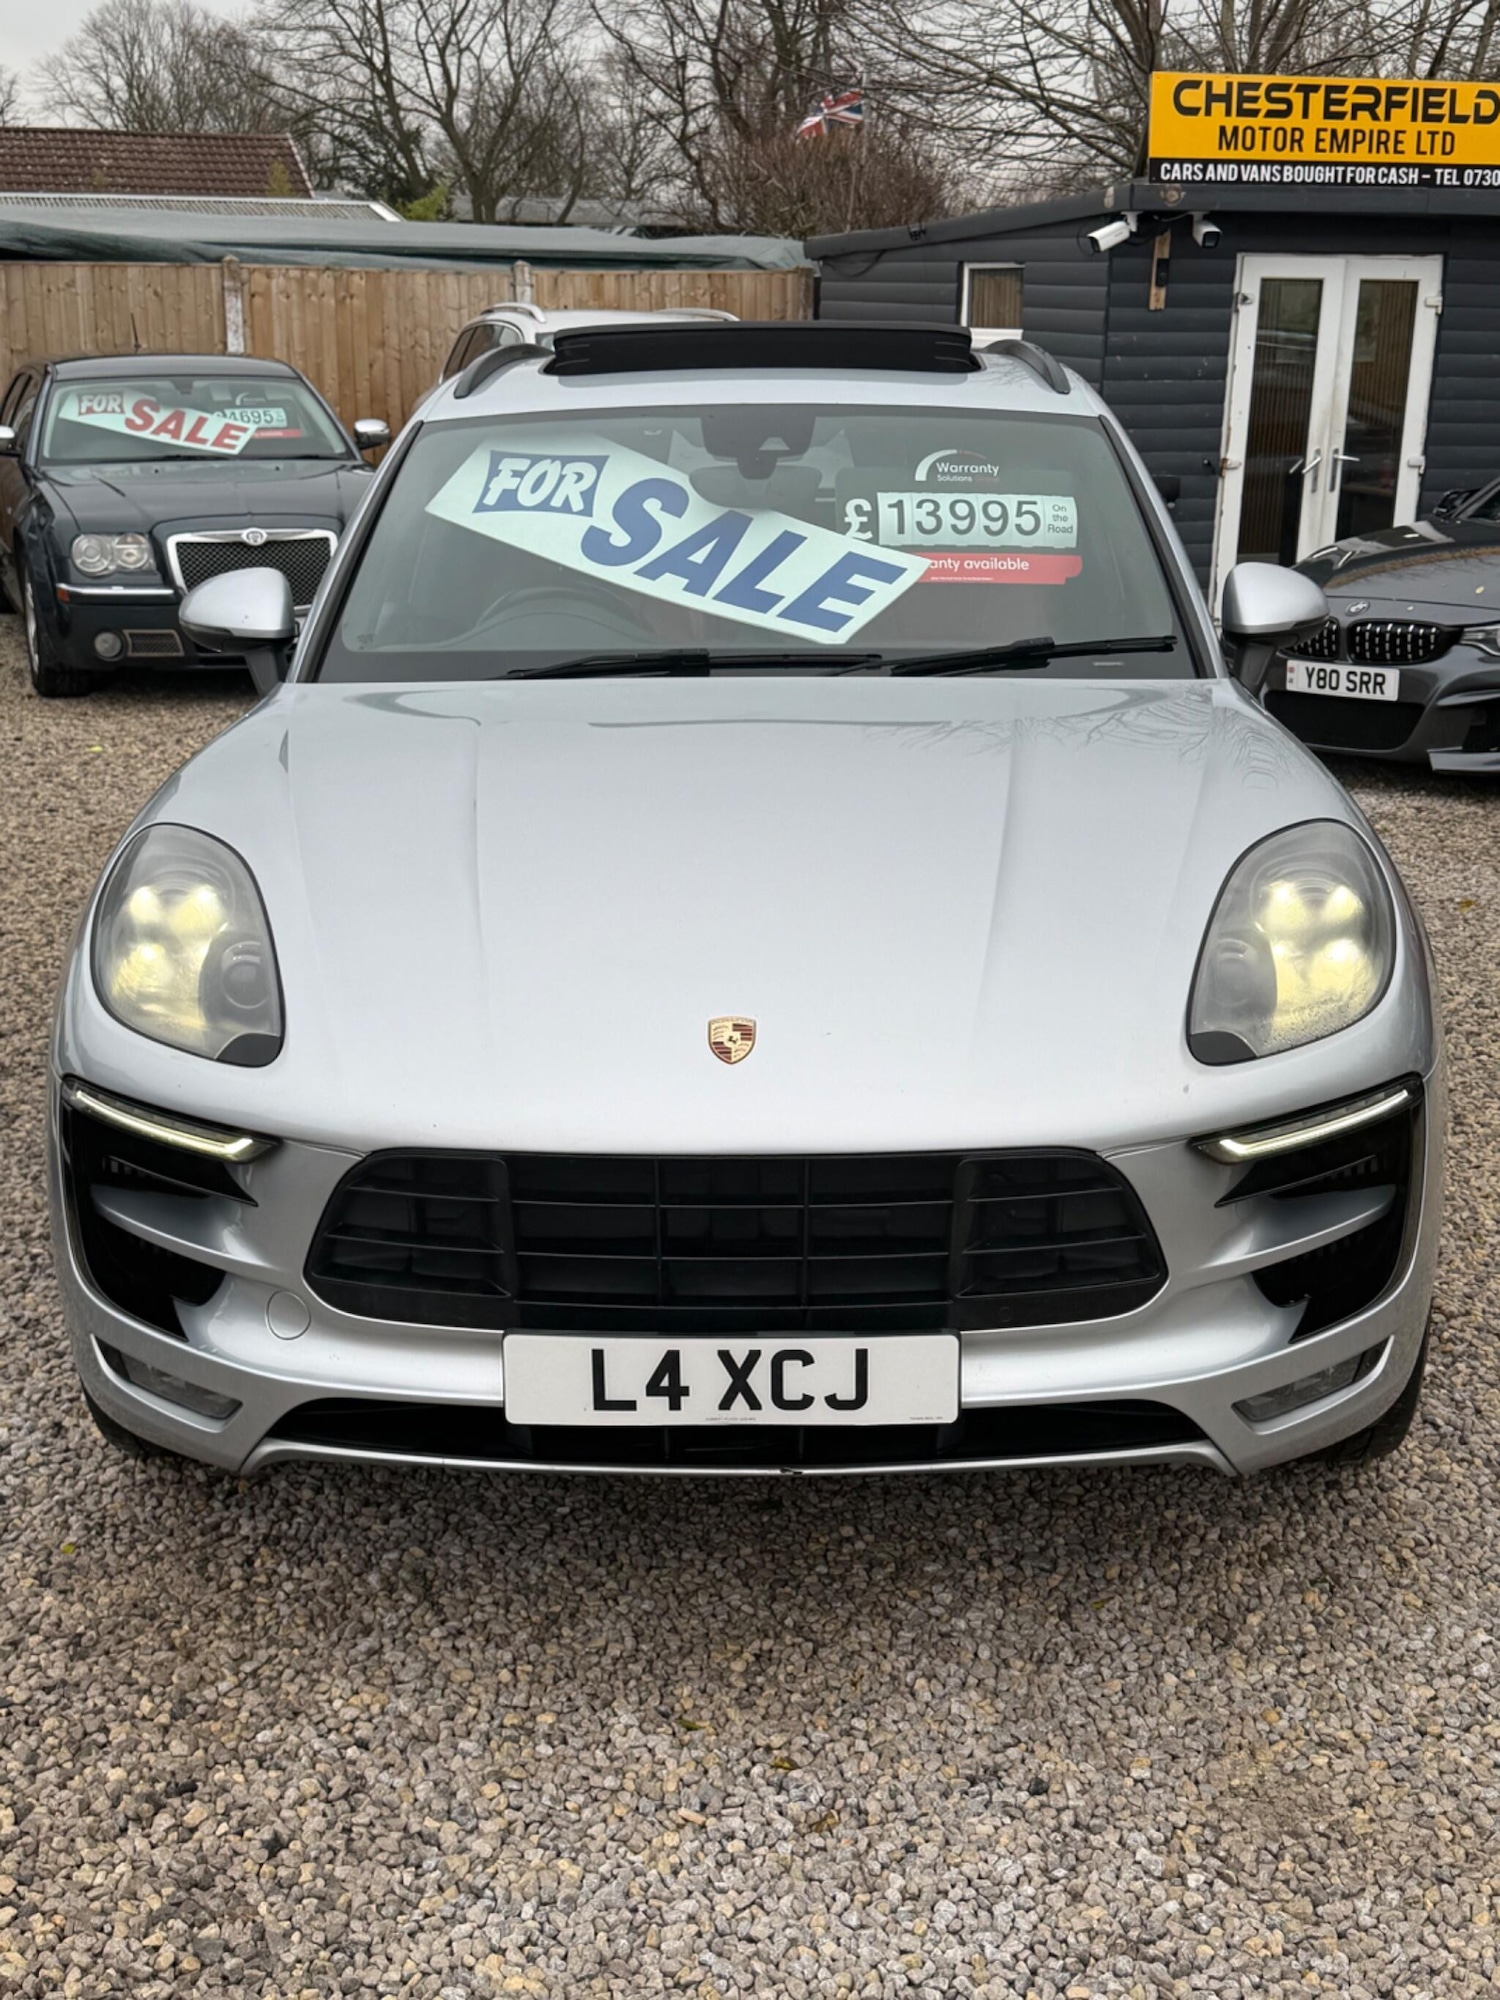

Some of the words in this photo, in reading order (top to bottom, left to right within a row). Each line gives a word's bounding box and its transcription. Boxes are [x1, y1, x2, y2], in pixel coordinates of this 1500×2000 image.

[1173, 79, 1500, 125] CHESTERFIELD
[1218, 125, 1304, 153] MOTOR
[1314, 127, 1407, 155] EMPIRE
[1415, 130, 1456, 156] LTD
[1160, 162, 1203, 181] CARS
[1205, 163, 1238, 182] AND
[1240, 164, 1282, 182] VANS
[1283, 165, 1345, 183] BOUGHT
[1346, 166, 1376, 184] FOR
[1377, 167, 1419, 185] CASH
[1434, 168, 1460, 186] TEL
[1463, 169, 1500, 187] 0730
[80, 393, 122, 413] FOR
[125, 398, 249, 450] SALE
[936, 462, 1000, 477] Warranty
[937, 474, 973, 482] Solutions
[1052, 504, 1067, 512] On
[1052, 514, 1069, 522] the
[1047, 523, 1073, 534] Road
[482, 457, 598, 512] FOR
[580, 477, 908, 633] SALE
[930, 558, 960, 572] anty
[963, 557, 1030, 570] available
[1305, 666, 1340, 691] Y80
[1345, 671, 1386, 695] SRR
[591, 1348, 690, 1412] L4
[717, 1348, 869, 1412] XCJ
